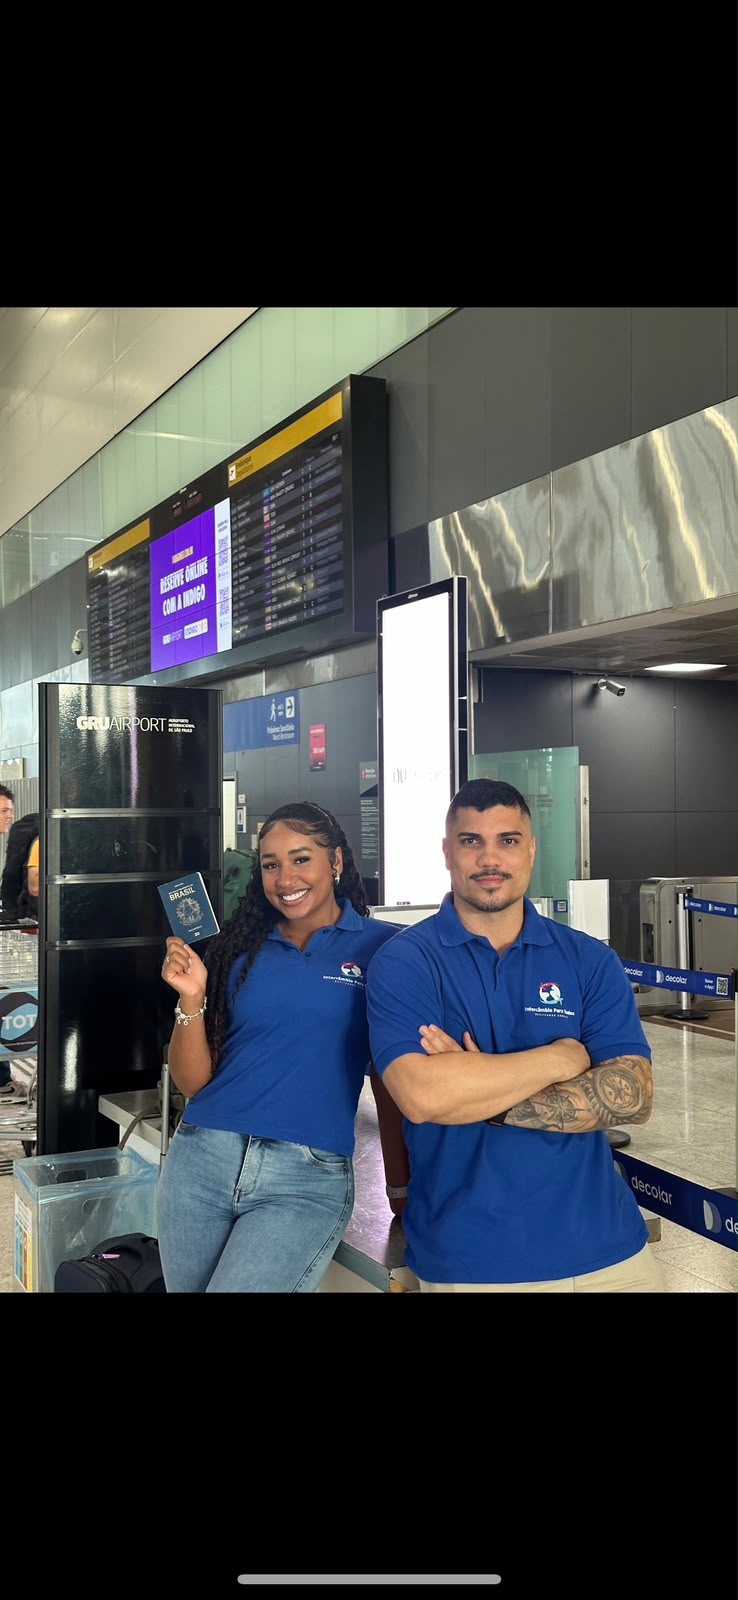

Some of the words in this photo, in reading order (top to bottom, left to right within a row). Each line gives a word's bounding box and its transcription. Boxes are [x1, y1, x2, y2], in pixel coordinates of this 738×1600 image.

[160, 567, 184, 595] RESERVE
[185, 556, 209, 583] ONLINE
[163, 596, 176, 617] COM
[177, 593, 183, 611] A
[183, 583, 206, 609] INDIGO
[169, 886, 196, 901] BRASIL
[665, 974, 688, 984] decolar
[631, 1176, 673, 1206] decolar
